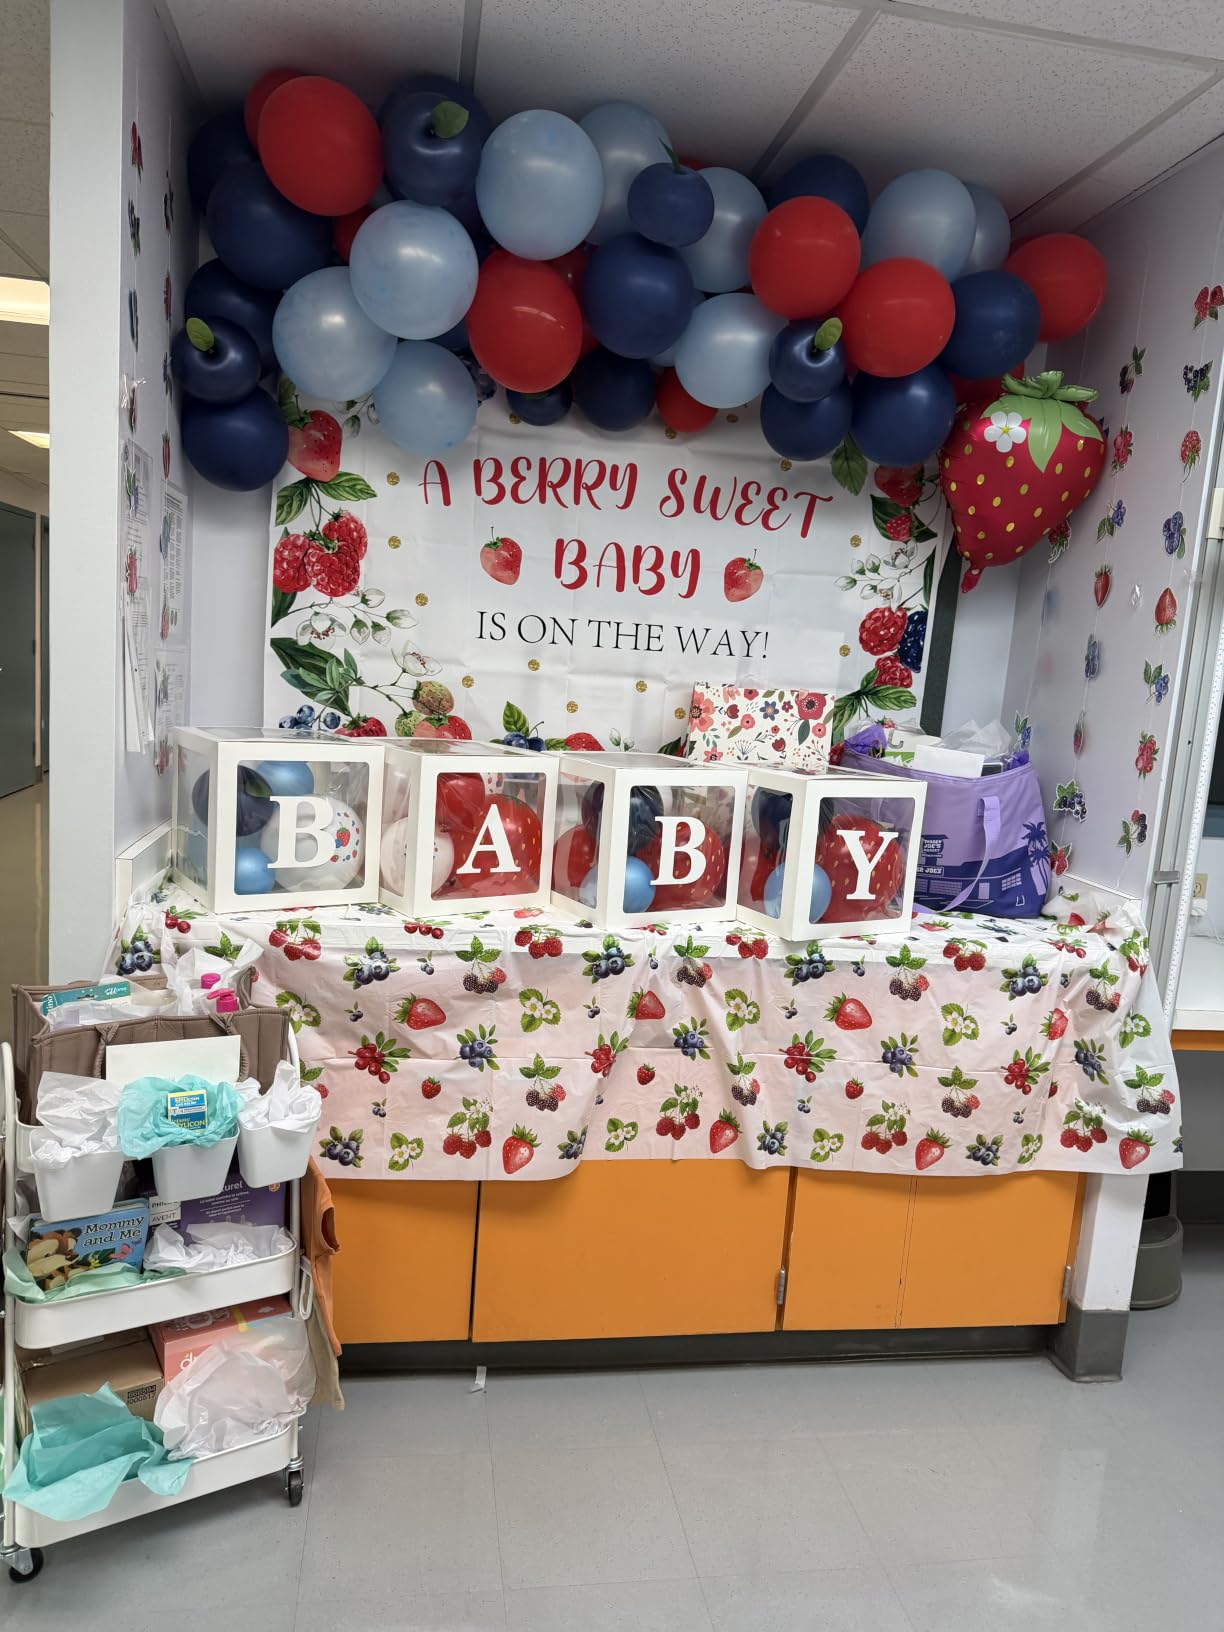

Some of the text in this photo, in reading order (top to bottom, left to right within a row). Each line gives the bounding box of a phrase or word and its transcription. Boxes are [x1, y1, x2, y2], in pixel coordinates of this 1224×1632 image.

[417, 456, 834, 539] A BERRY SWEET
[554, 537, 701, 599] BABY
[476, 610, 769, 660] IS ON THE WAY!
[267, 796, 899, 900] B A B Y
[83, 1229, 142, 1247] and Me
[85, 1216, 145, 1235] Mommy
[152, 1212, 176, 1223] AVENT
